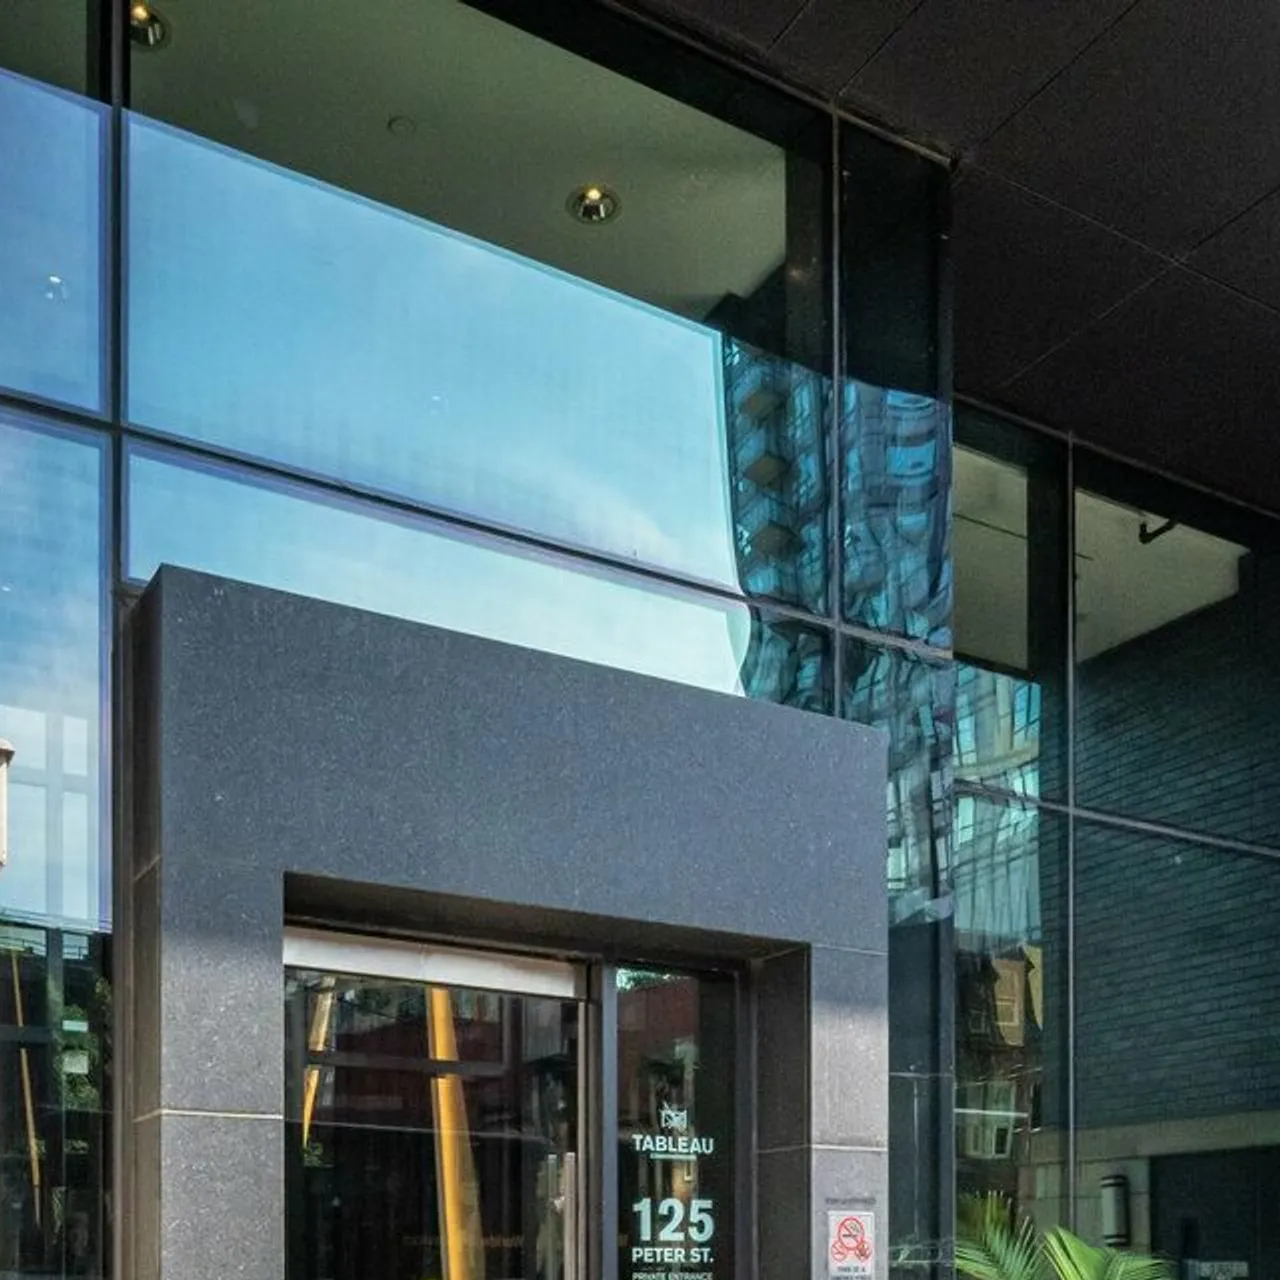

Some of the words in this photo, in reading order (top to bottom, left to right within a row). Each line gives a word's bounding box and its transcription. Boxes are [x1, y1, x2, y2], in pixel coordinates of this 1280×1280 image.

[631, 1134, 714, 1153] TABLEAU
[632, 1197, 714, 1242] 125
[631, 1247, 685, 1263] PETER
[690, 1247, 714, 1263] ST.
[632, 1271, 666, 1280] PRIVATE
[668, 1271, 713, 1280] ENTRANCE
